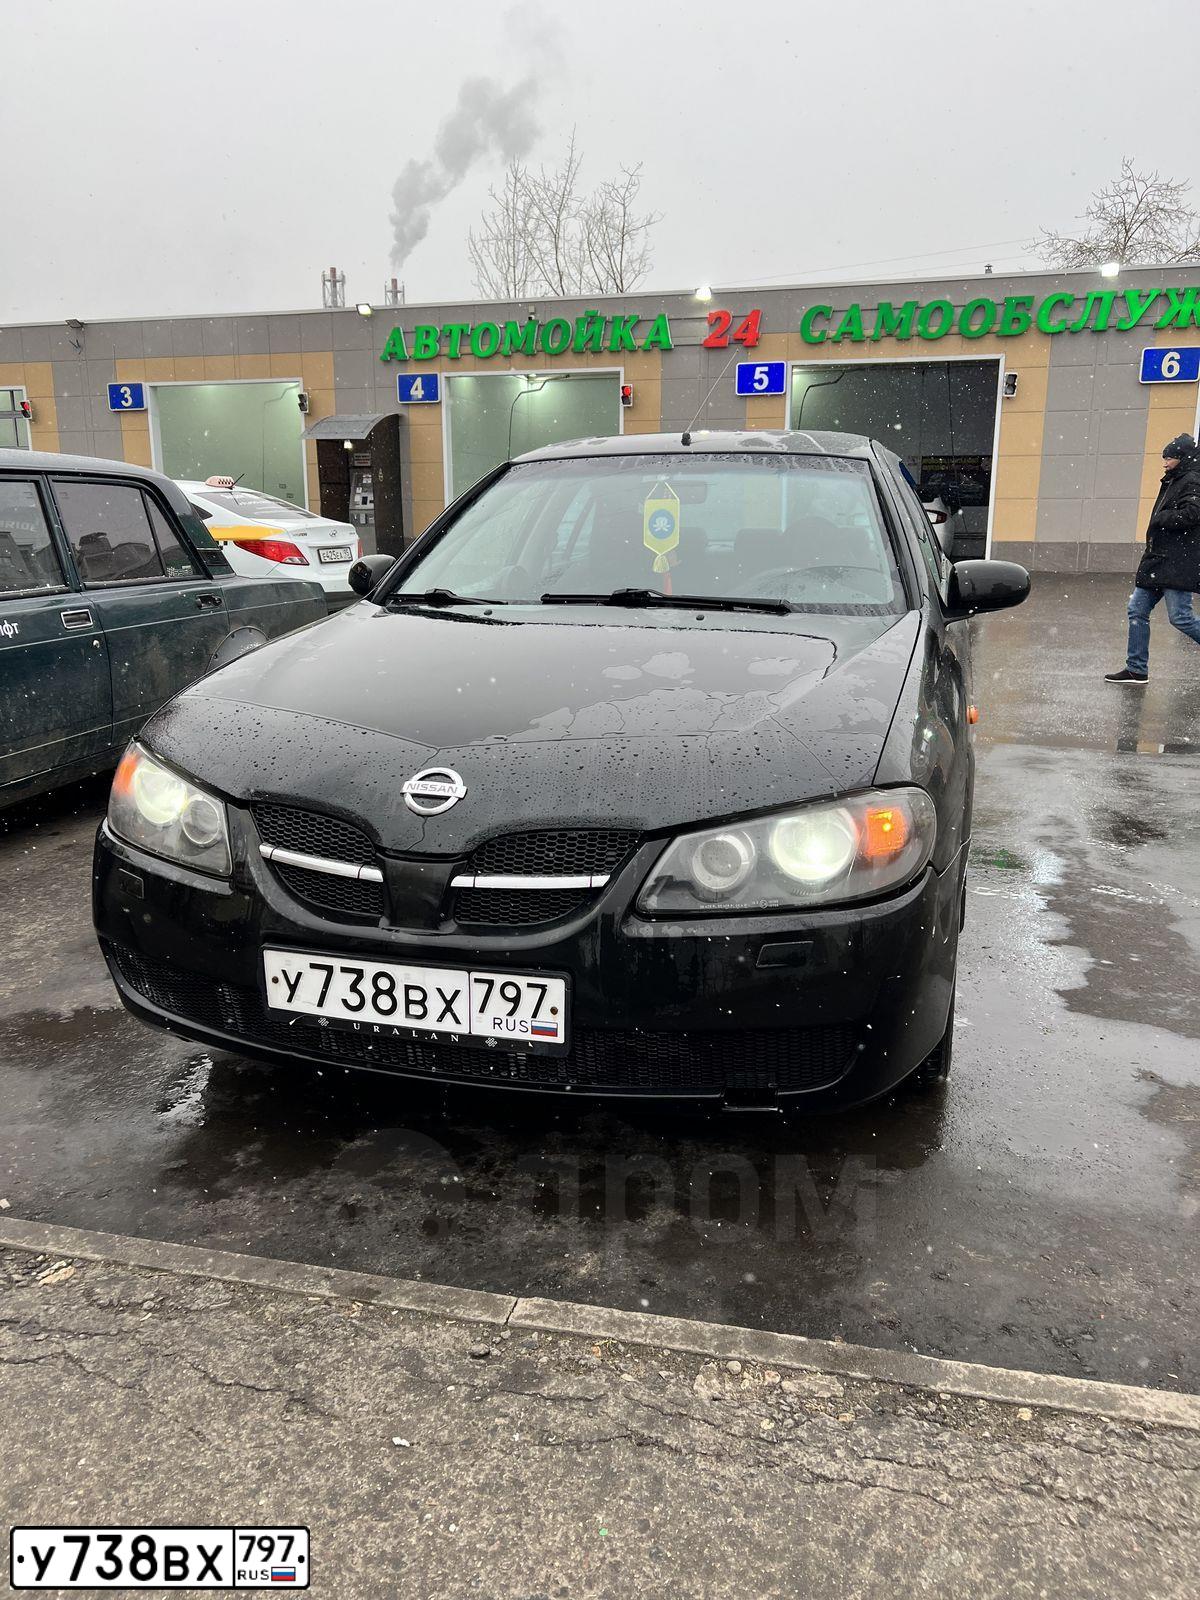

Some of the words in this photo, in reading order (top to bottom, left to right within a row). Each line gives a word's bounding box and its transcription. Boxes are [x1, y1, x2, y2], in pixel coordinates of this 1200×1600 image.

[379, 309, 674, 361] АВТОМОЙКА
[703, 308, 762, 348] 24
[799, 286, 1200, 344] САМООБСЛУЖ
[1161, 351, 1181, 378] 6
[409, 376, 425, 399] 4
[753, 366, 769, 390] 5
[120, 386, 133, 407] 3
[406, 783, 458, 794] NISSAN
[281, 962, 461, 1025] У738ВХ
[473, 977, 548, 1019] 797
[352, 1022, 460, 1043] URALAN
[492, 1017, 529, 1034] RUS
